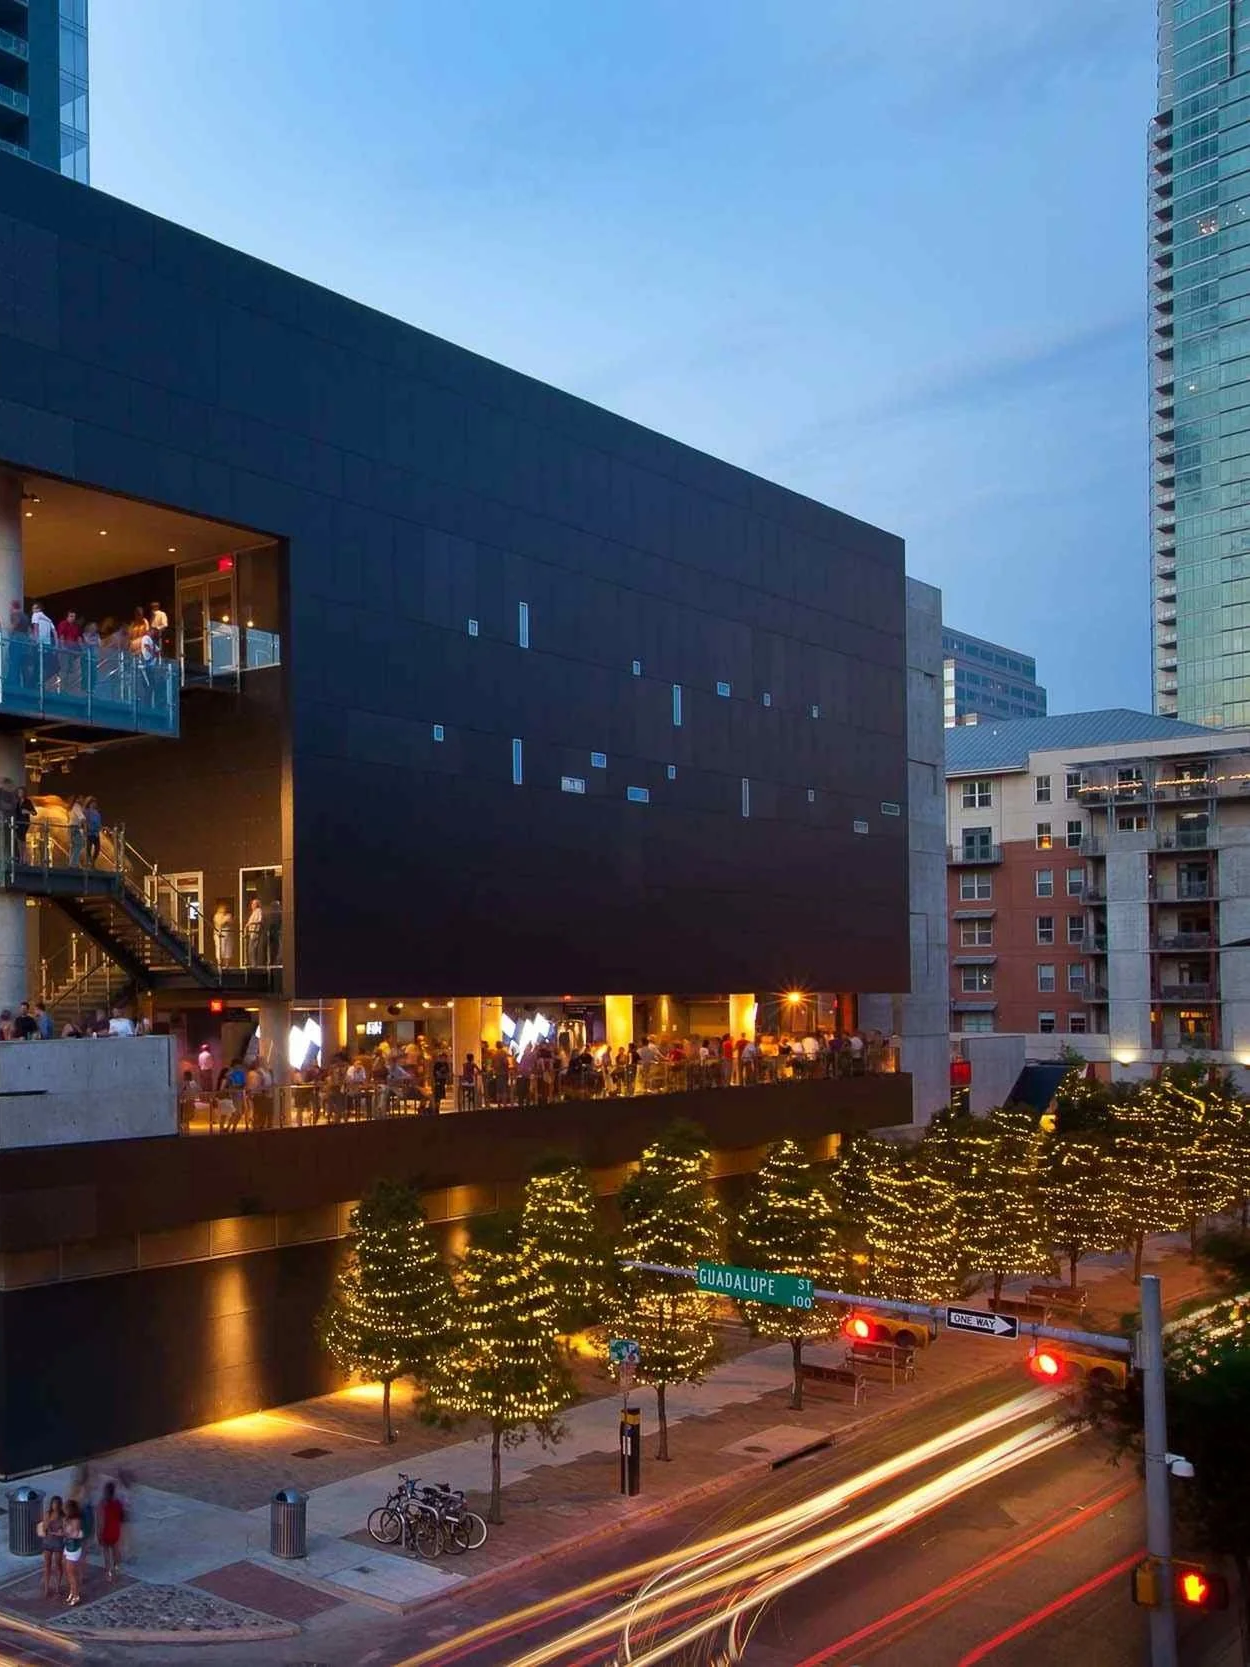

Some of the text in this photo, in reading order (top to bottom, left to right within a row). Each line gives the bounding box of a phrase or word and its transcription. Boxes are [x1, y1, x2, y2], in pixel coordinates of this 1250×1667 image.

[699, 1267, 812, 1296] GUADALUPE ST
[792, 1295, 812, 1309] 100
[953, 1314, 997, 1329] ONE WAY
